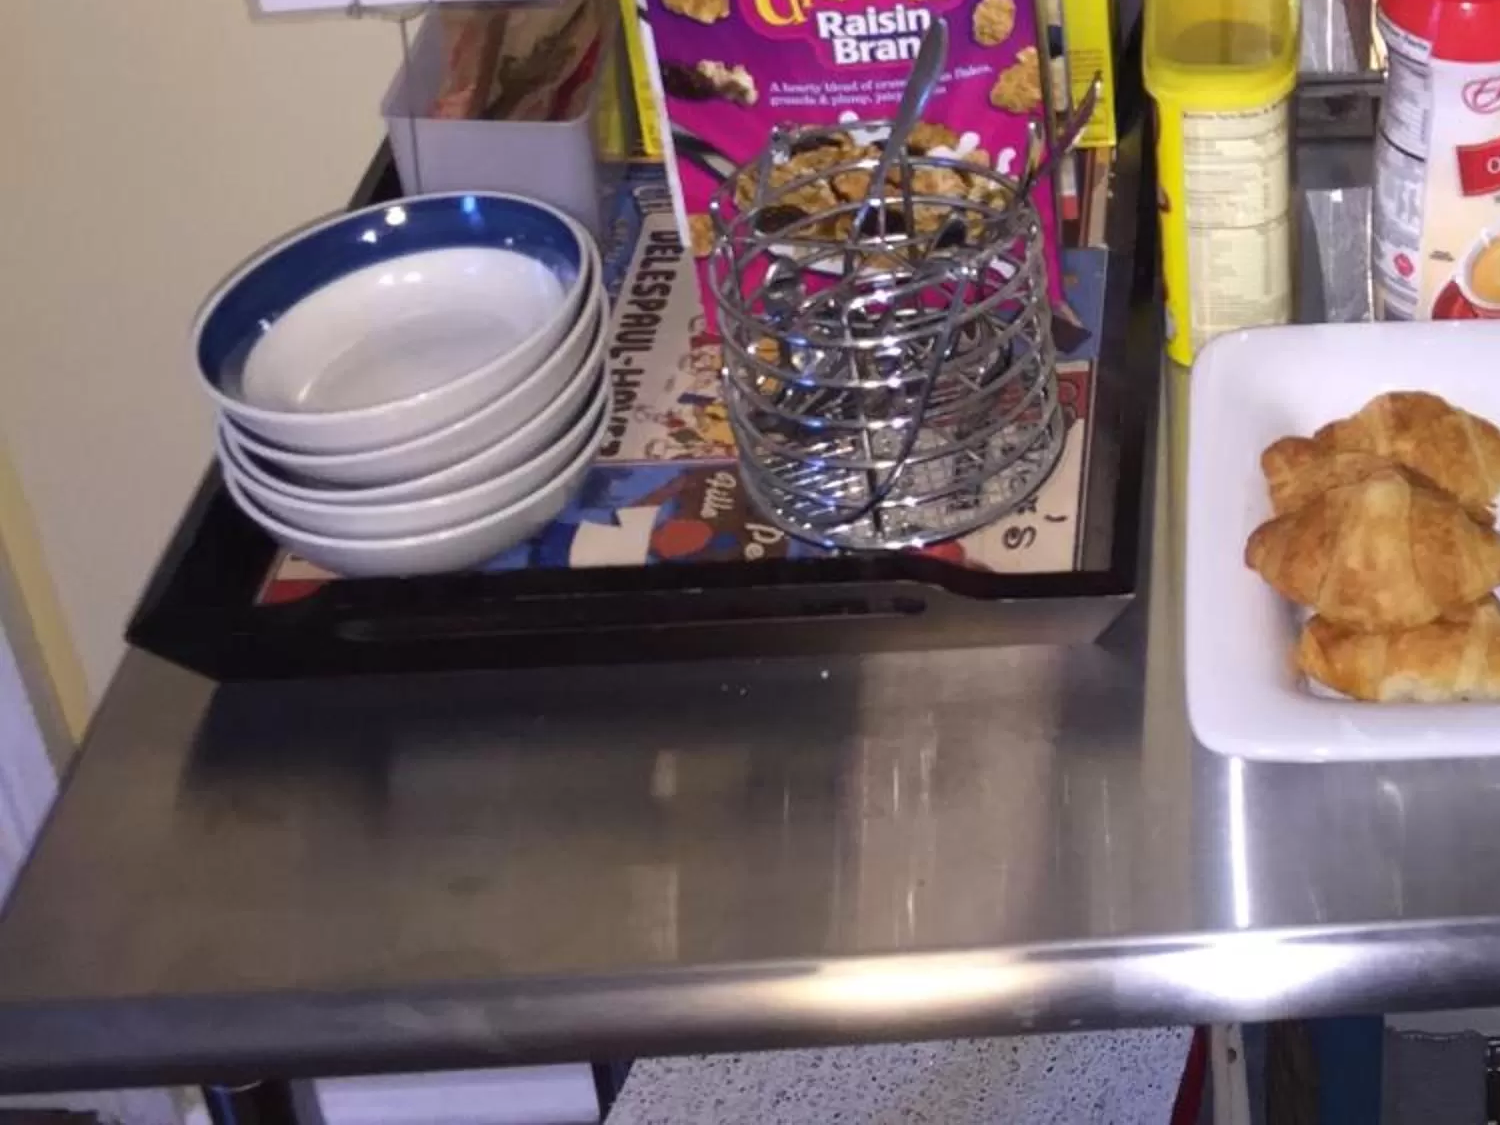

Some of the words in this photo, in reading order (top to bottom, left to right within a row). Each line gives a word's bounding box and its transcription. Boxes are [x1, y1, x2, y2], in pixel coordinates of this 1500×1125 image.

[816, 6, 931, 39] Raisin
[834, 33, 921, 65] Bran
[824, 80, 858, 92] blend
